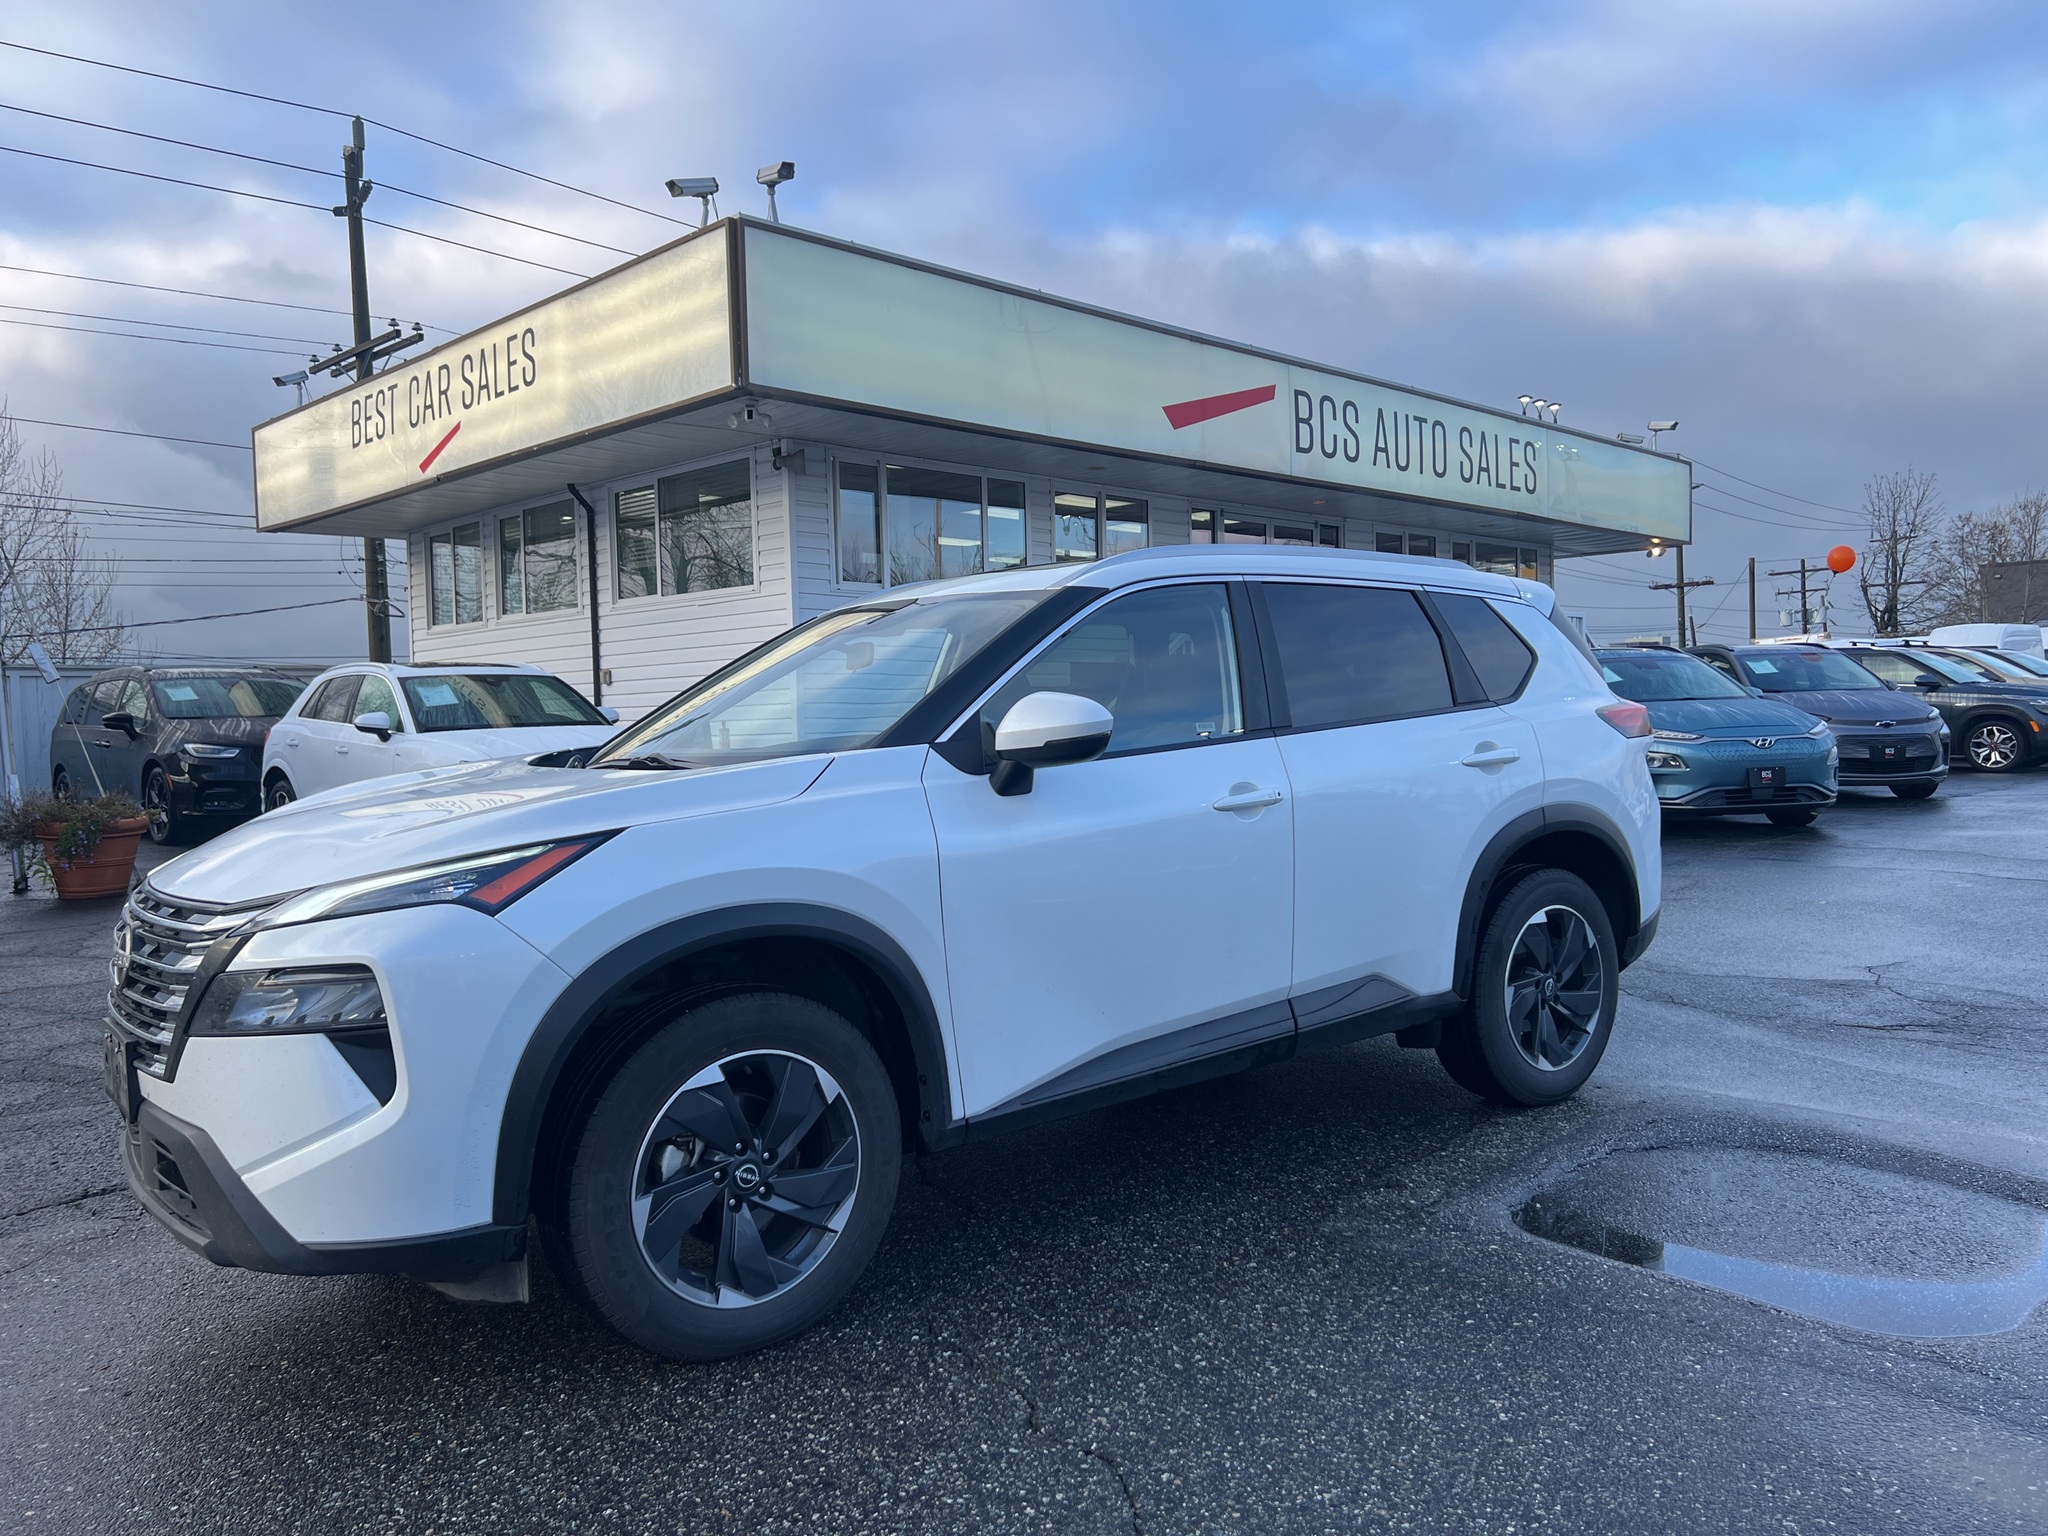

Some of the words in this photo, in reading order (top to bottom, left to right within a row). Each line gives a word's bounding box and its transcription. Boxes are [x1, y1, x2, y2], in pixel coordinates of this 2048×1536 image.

[352, 383, 398, 449] BEST
[408, 363, 452, 429] CAR
[461, 327, 537, 411] SALES
[1294, 389, 1360, 463] BCS
[1372, 407, 1448, 479] AUTO
[1459, 426, 1537, 495] SALES
[1761, 770, 1772, 778] BCS
